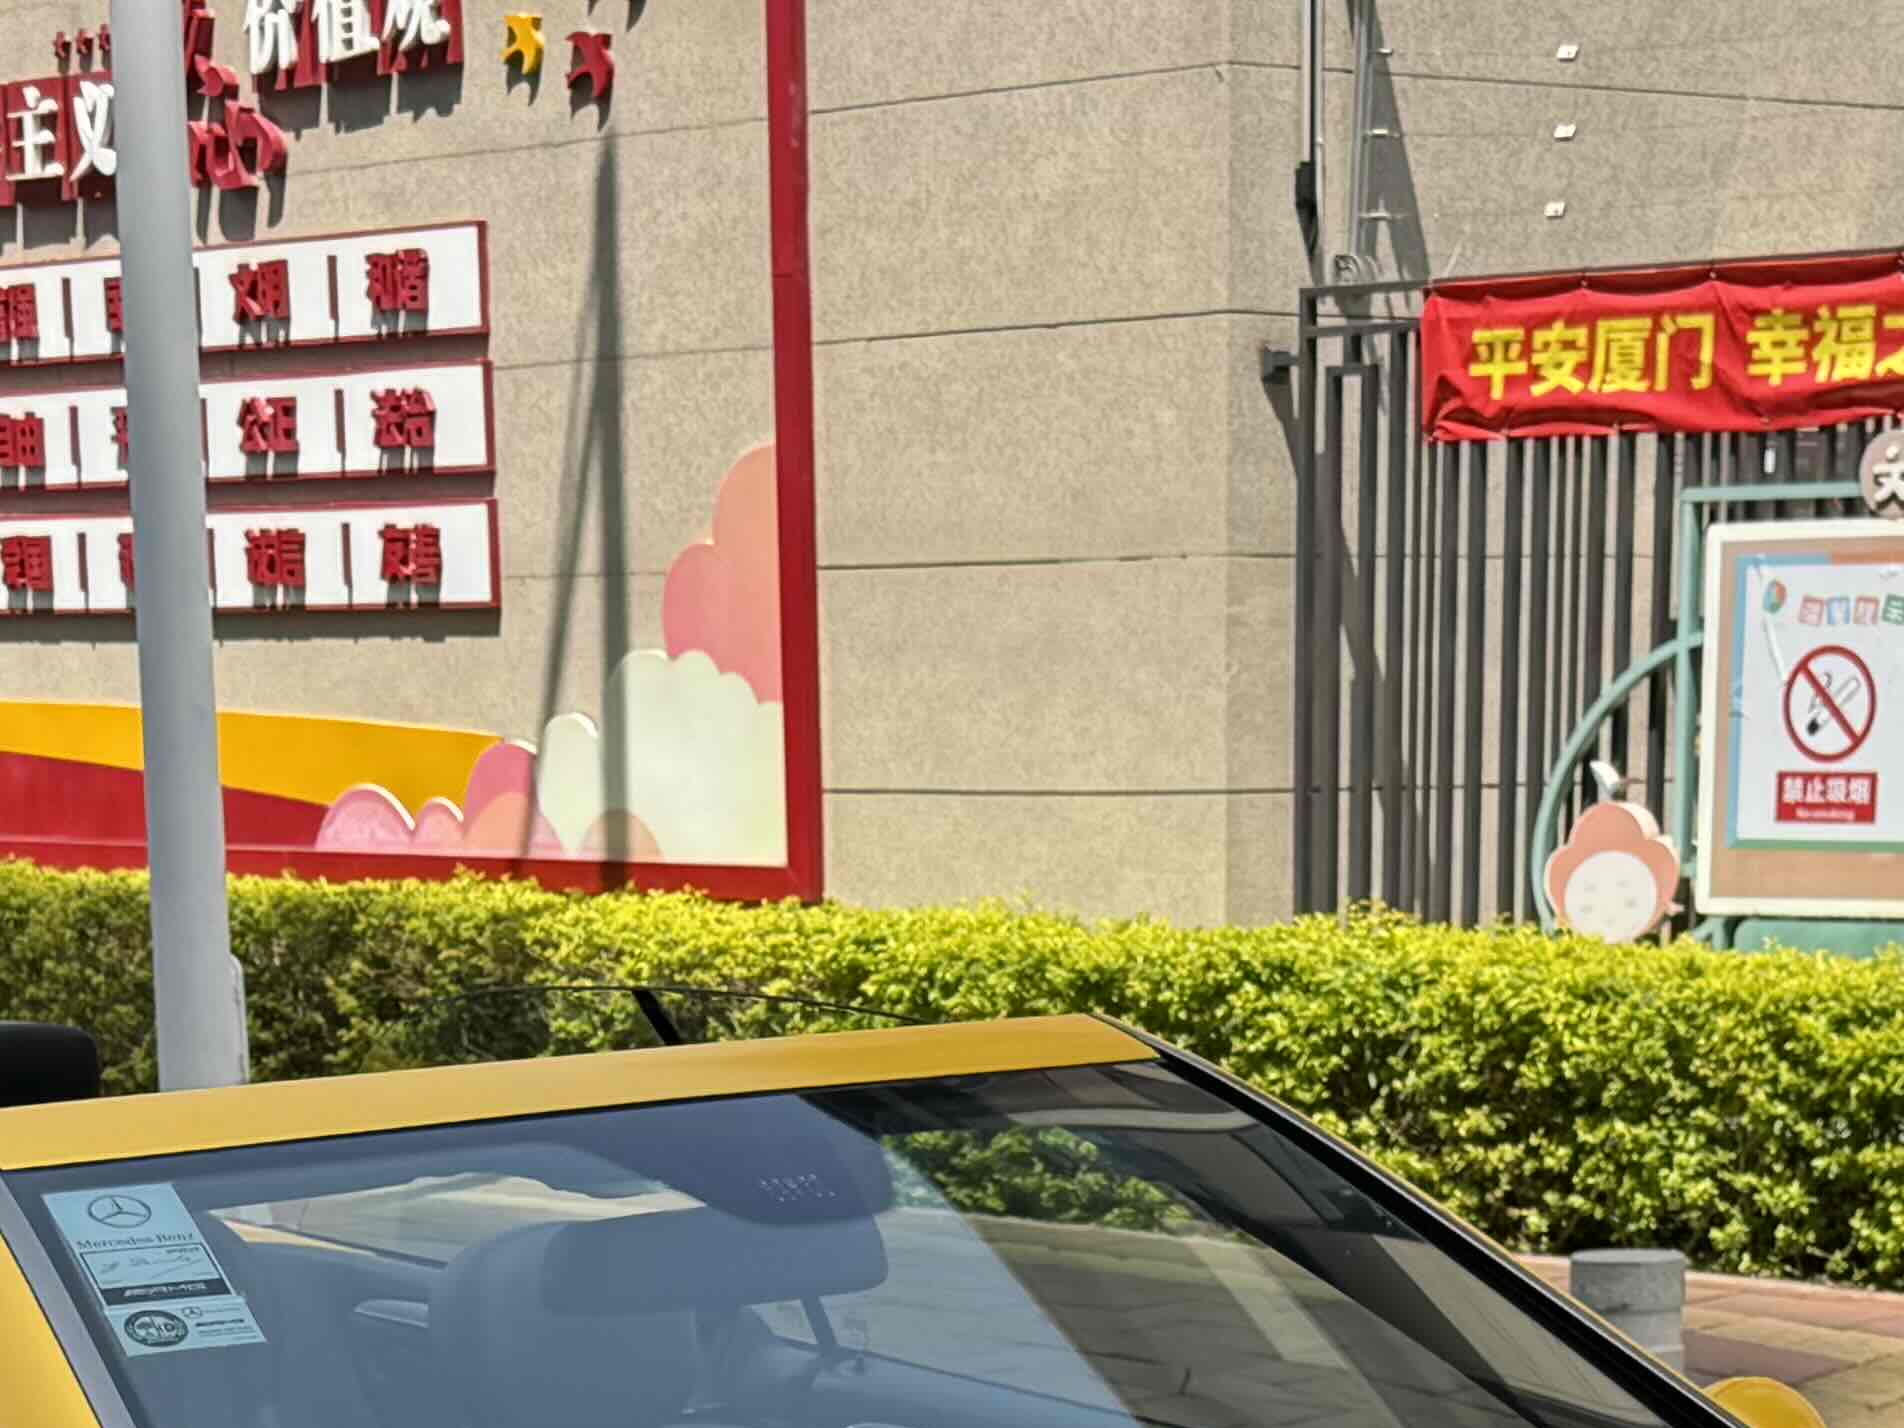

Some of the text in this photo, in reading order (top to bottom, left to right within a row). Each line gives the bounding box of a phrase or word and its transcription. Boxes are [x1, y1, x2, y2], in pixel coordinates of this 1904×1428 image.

[228, 258, 290, 323] 文明
[365, 248, 430, 312] 和谐
[1468, 311, 1716, 401] 平安厦门
[237, 395, 300, 453] 公正
[370, 387, 437, 449] 法治
[0, 535, 54, 592] 爱国
[244, 528, 306, 587] 诚信
[378, 523, 442, 586] 友善
[1783, 777, 1872, 804] 禁止吸烟
